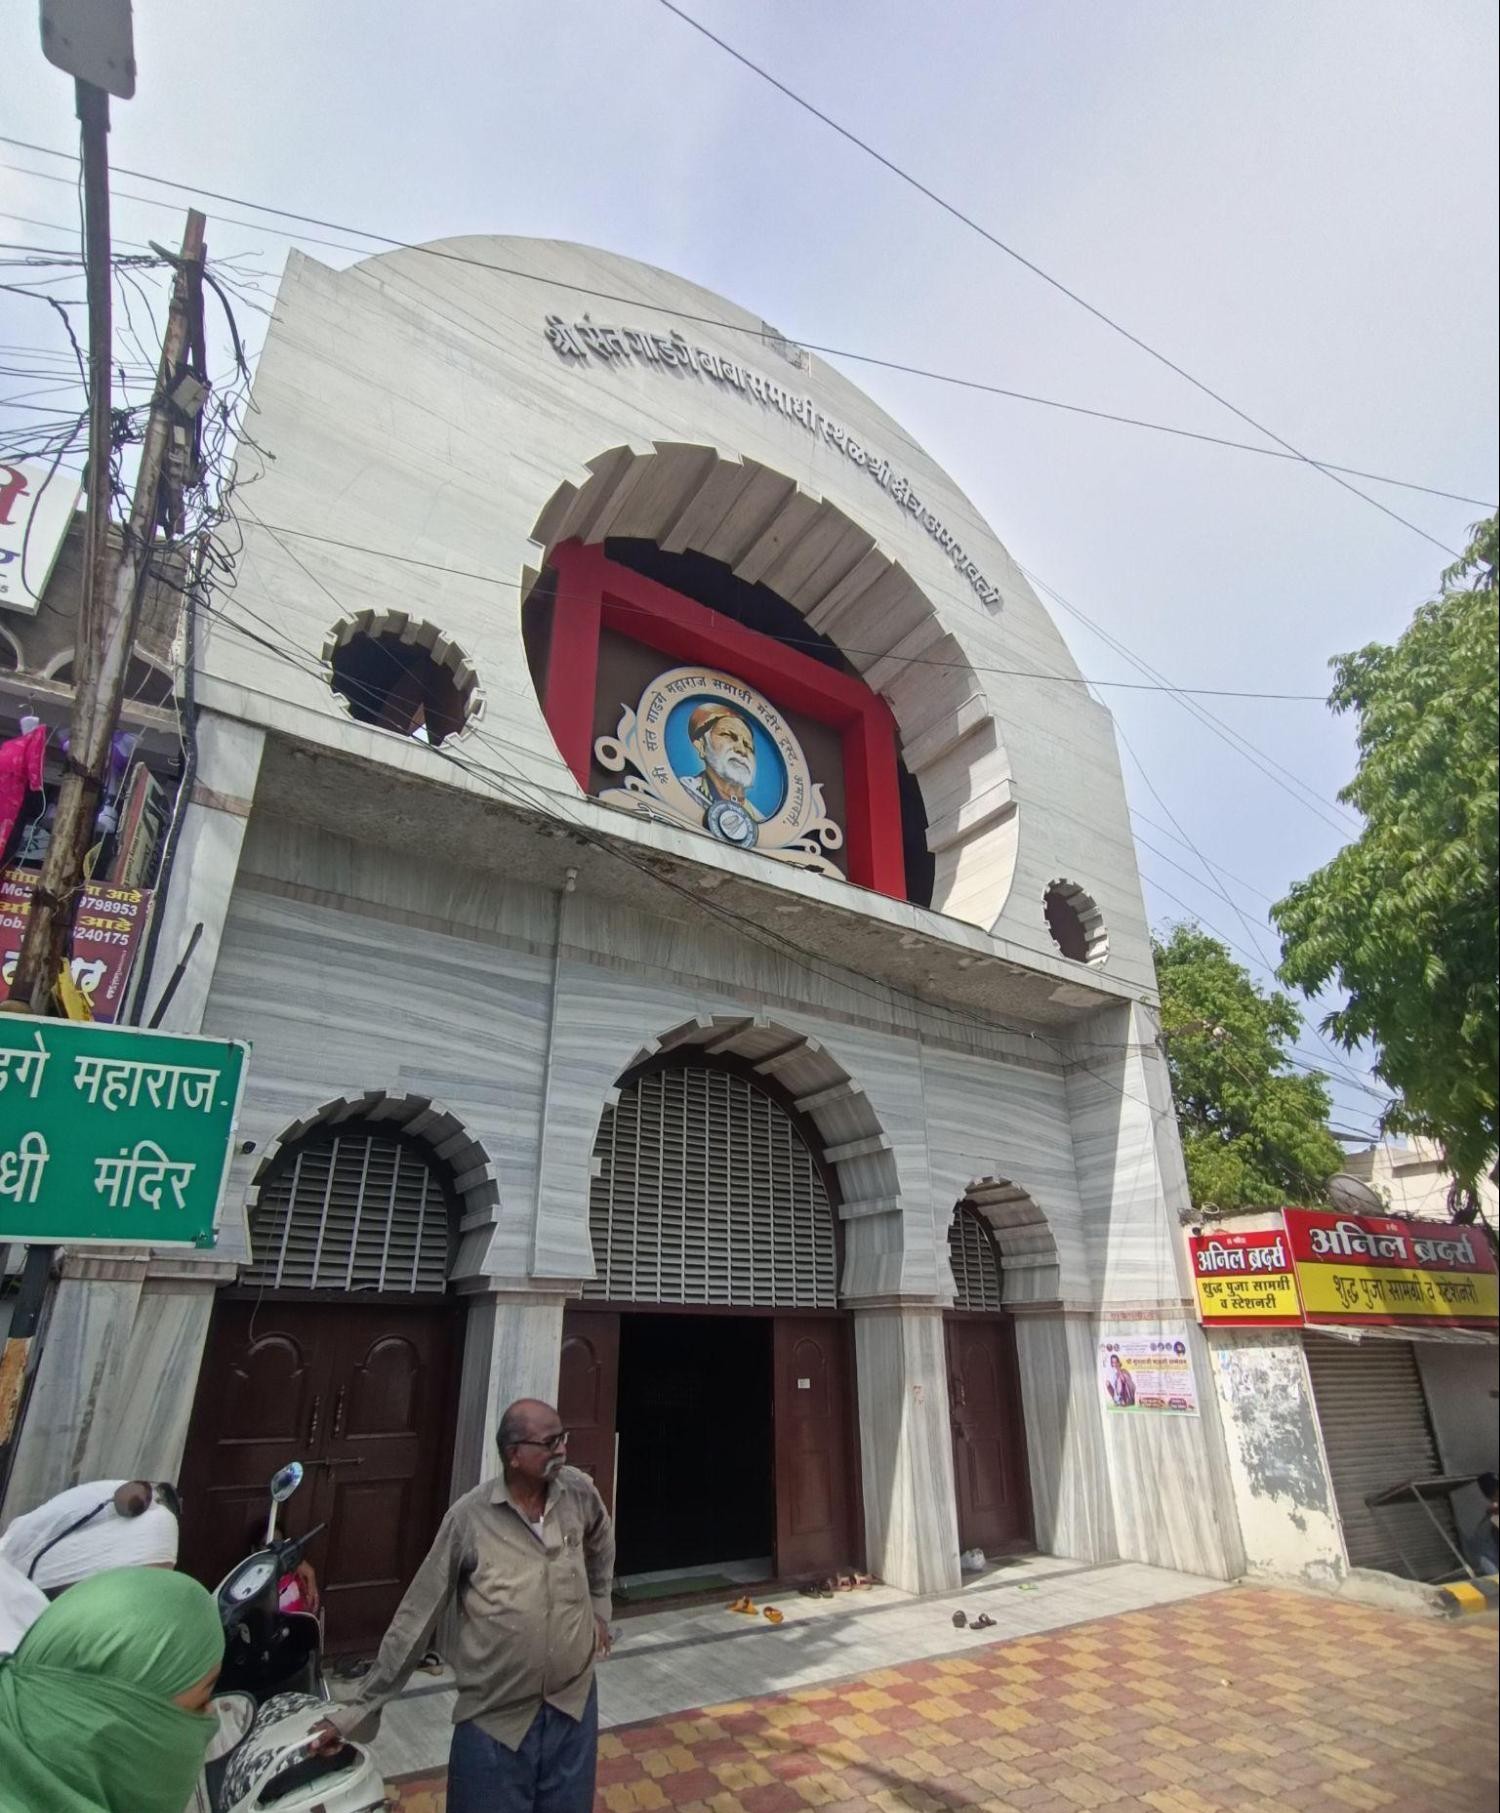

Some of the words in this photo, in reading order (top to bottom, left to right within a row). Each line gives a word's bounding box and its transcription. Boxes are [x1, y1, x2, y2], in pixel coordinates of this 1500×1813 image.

[544, 314, 586, 358] श्री
[575, 312, 630, 361] संत
[698, 348, 746, 391] बाबा
[665, 676, 706, 693] महाराज
[712, 678, 753, 704] समाधी
[643, 729, 659, 752] संत
[654, 766, 669, 785] श्री
[73, 1055, 221, 1113] महाराज
[94, 1140, 197, 1210] मंदिर
[1197, 1242, 1245, 1271] अनिल
[1247, 1237, 1286, 1271] ब्रदर्स
[1310, 1221, 1408, 1260] अनिल
[1410, 1233, 1477, 1266] ब्रदर्स
[1220, 1299, 1228, 1309] व
[1424, 1281, 1435, 1302] व
